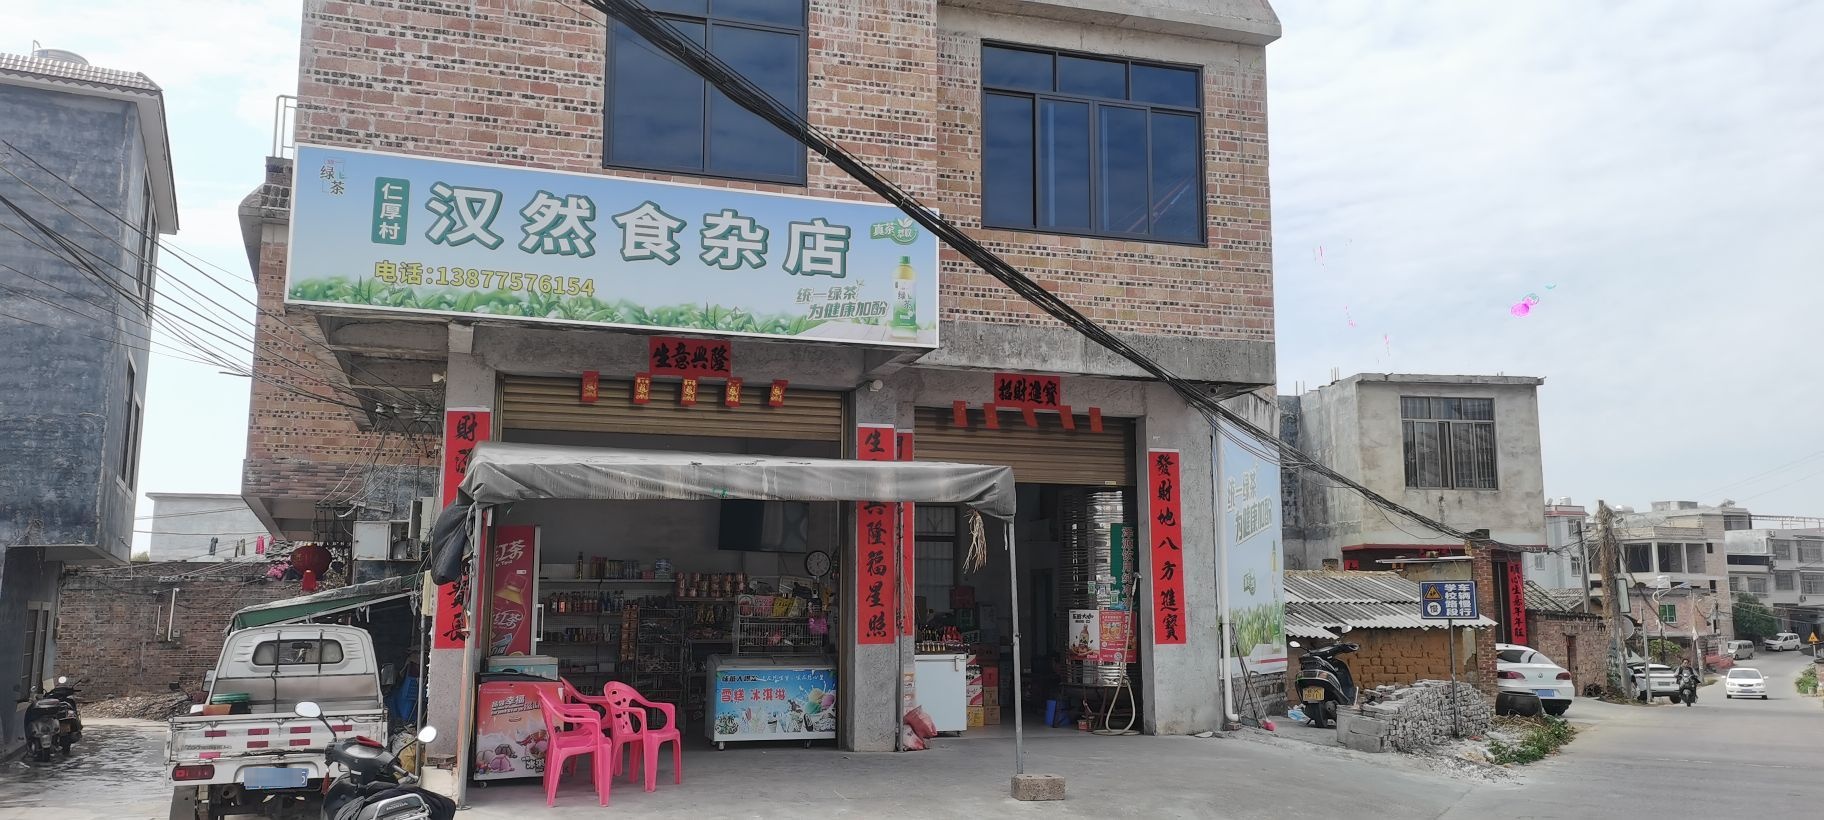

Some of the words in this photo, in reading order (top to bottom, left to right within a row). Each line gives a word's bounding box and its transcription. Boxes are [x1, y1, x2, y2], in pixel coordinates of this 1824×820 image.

[320, 165, 344, 195] 绿茶
[379, 182, 403, 240] 仁厚村
[425, 181, 850, 278] 汉然食杂店
[374, 260, 594, 297] 电话:13877576154
[796, 284, 858, 304] 统一绿茶
[807, 301, 888, 321] 为健康加酚
[653, 342, 729, 372] 生意興隆
[998, 378, 1058, 407] 招財進寶
[863, 429, 888, 639] 生隆福星照
[1156, 454, 1180, 641] 發財地八方進寶
[1444, 583, 1459, 616] 学校路段
[1458, 583, 1473, 616] 车辆慢行
[721, 687, 745, 703] 雪糕
[750, 687, 786, 701] 冰淇淋
